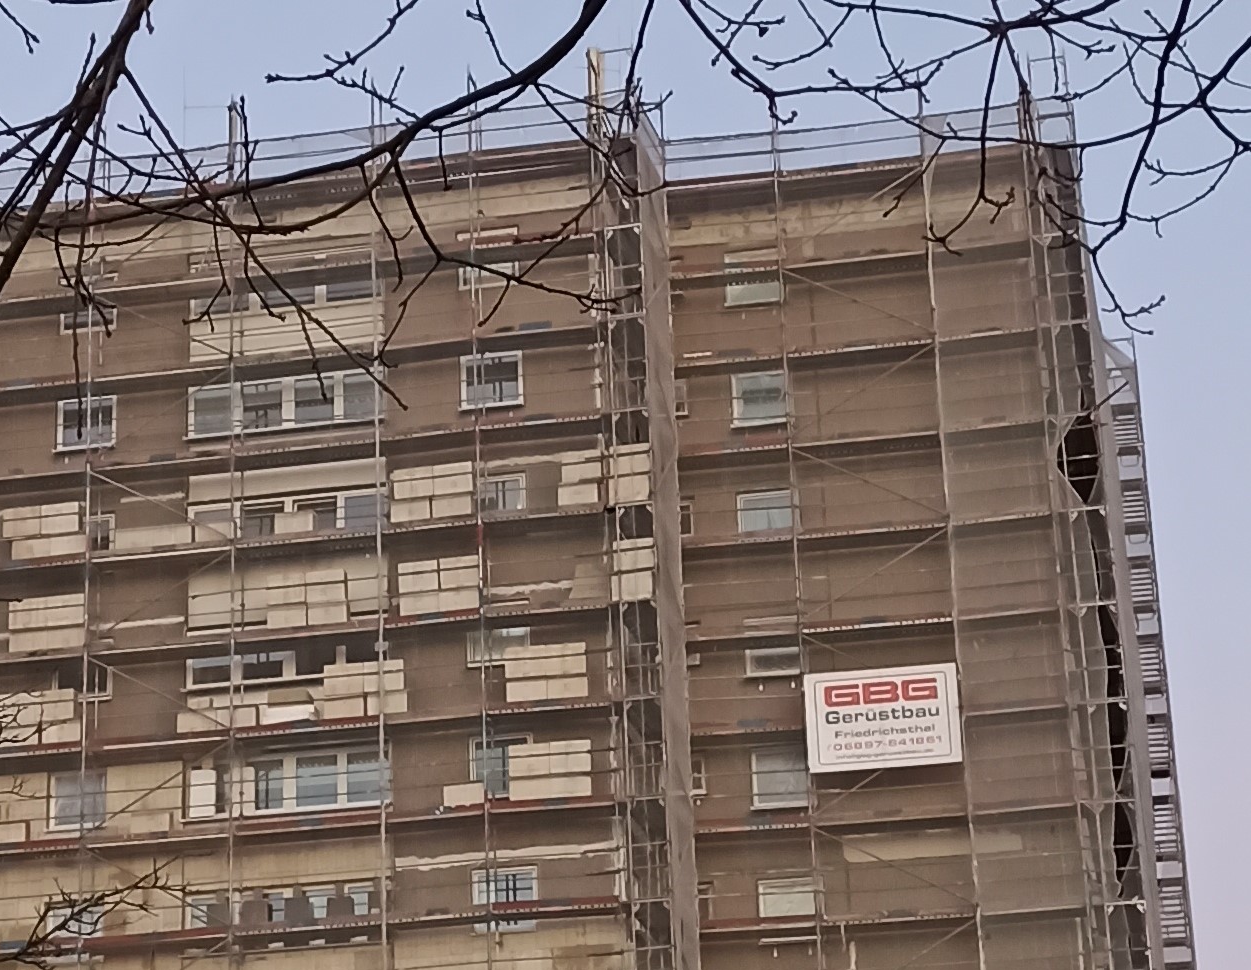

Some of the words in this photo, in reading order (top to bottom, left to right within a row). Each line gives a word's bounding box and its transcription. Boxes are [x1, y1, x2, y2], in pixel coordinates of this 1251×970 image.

[824, 677, 938, 707] GBG
[825, 705, 940, 724] Gerüstbau
[834, 723, 936, 739] Friedrichsthal
